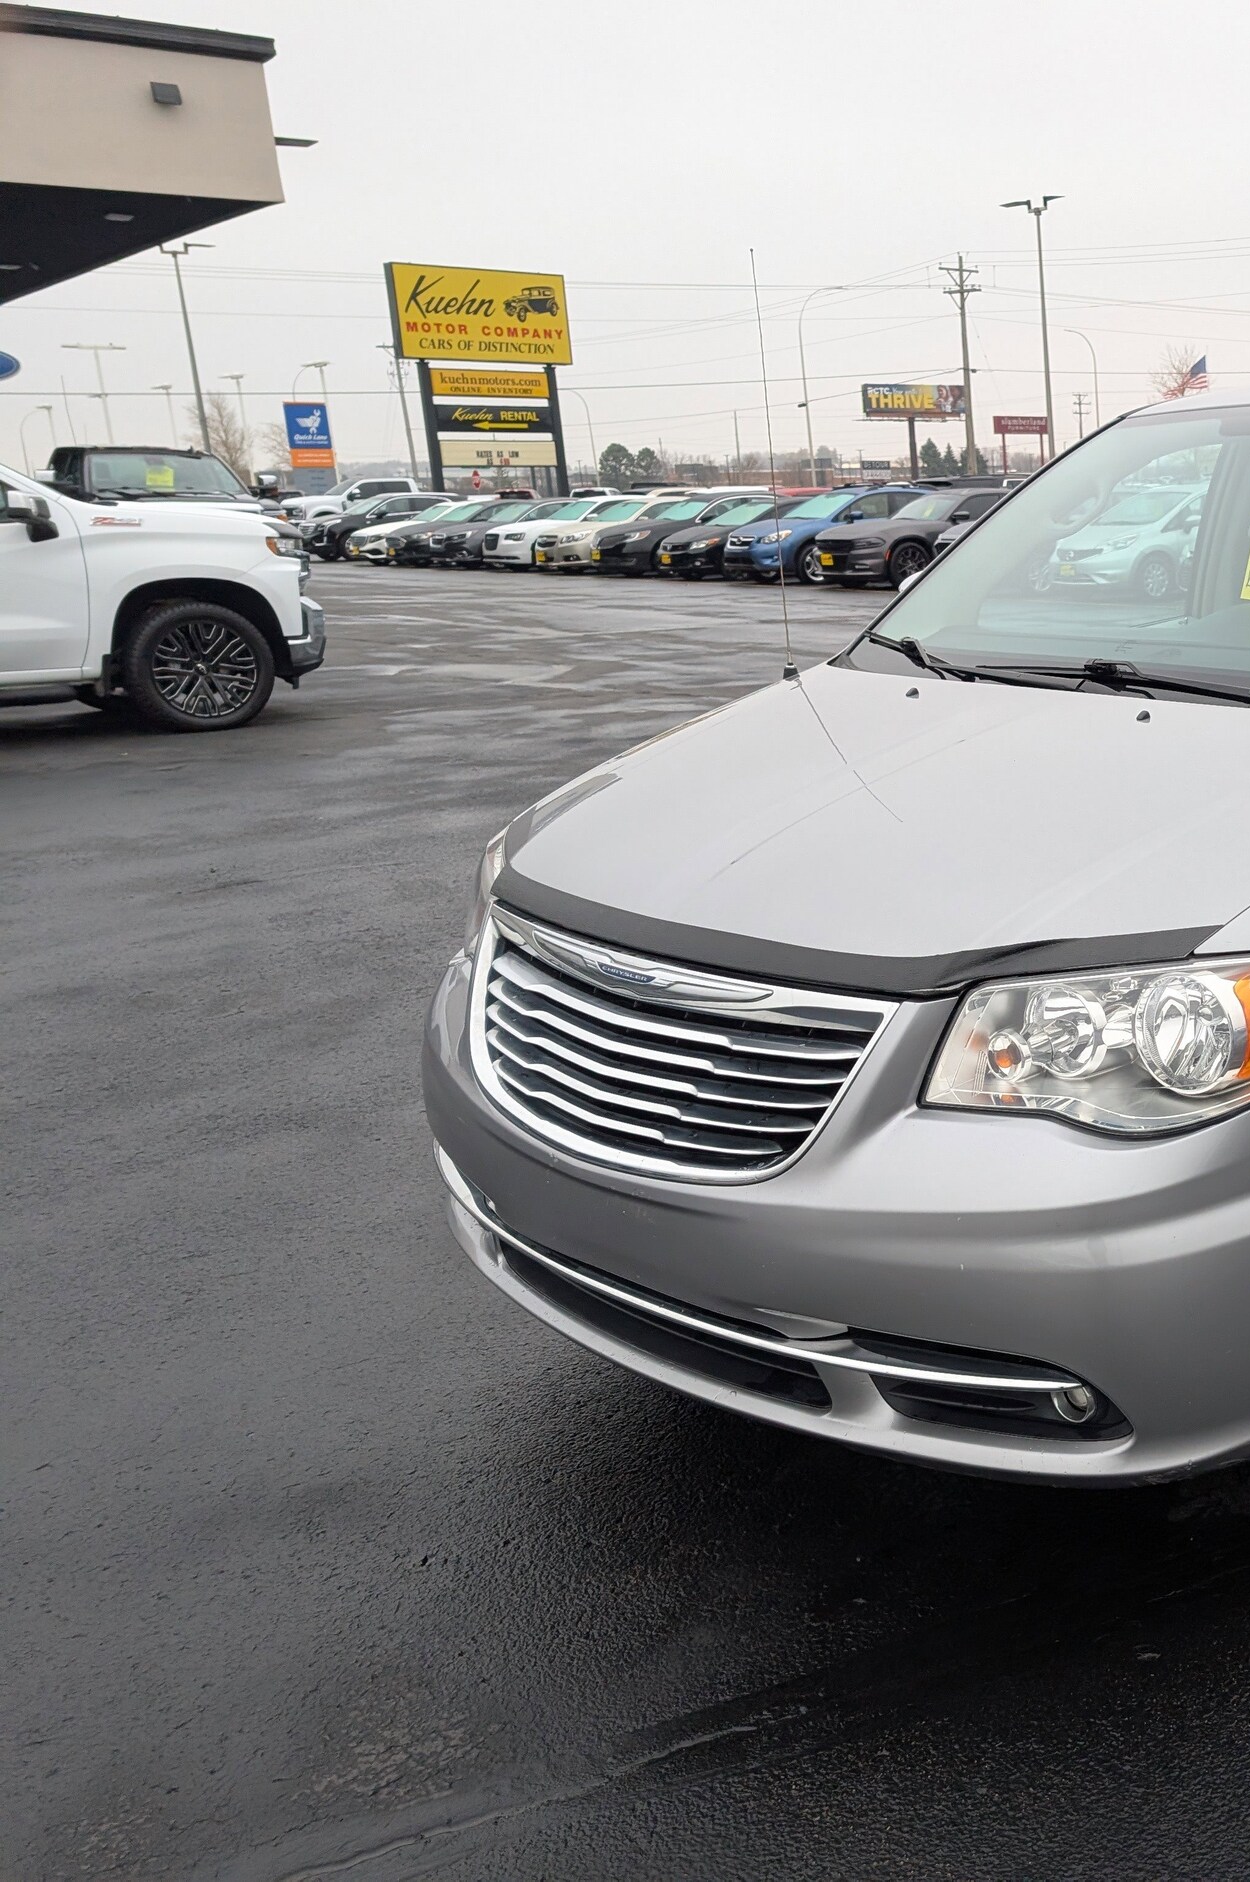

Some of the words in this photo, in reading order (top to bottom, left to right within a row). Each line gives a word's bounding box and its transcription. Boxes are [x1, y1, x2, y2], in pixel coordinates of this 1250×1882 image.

[404, 274, 496, 319] Kuehn
[405, 321, 468, 335] MOTOR
[481, 325, 563, 340] COMPANY
[419, 338, 453, 350] CARS
[457, 339, 474, 351] OF
[478, 341, 555, 354] DISTINCTION
[439, 372, 541, 387] kuehnmotors.com
[450, 386, 482, 394] ONLINE
[487, 387, 534, 395] INVENTORY
[868, 393, 936, 409] THRIVE
[451, 407, 494, 422] Kuehn
[500, 411, 540, 422] RENTAL
[1001, 417, 1046, 426] slumberland
[601, 964, 649, 982] CHRYSLER
